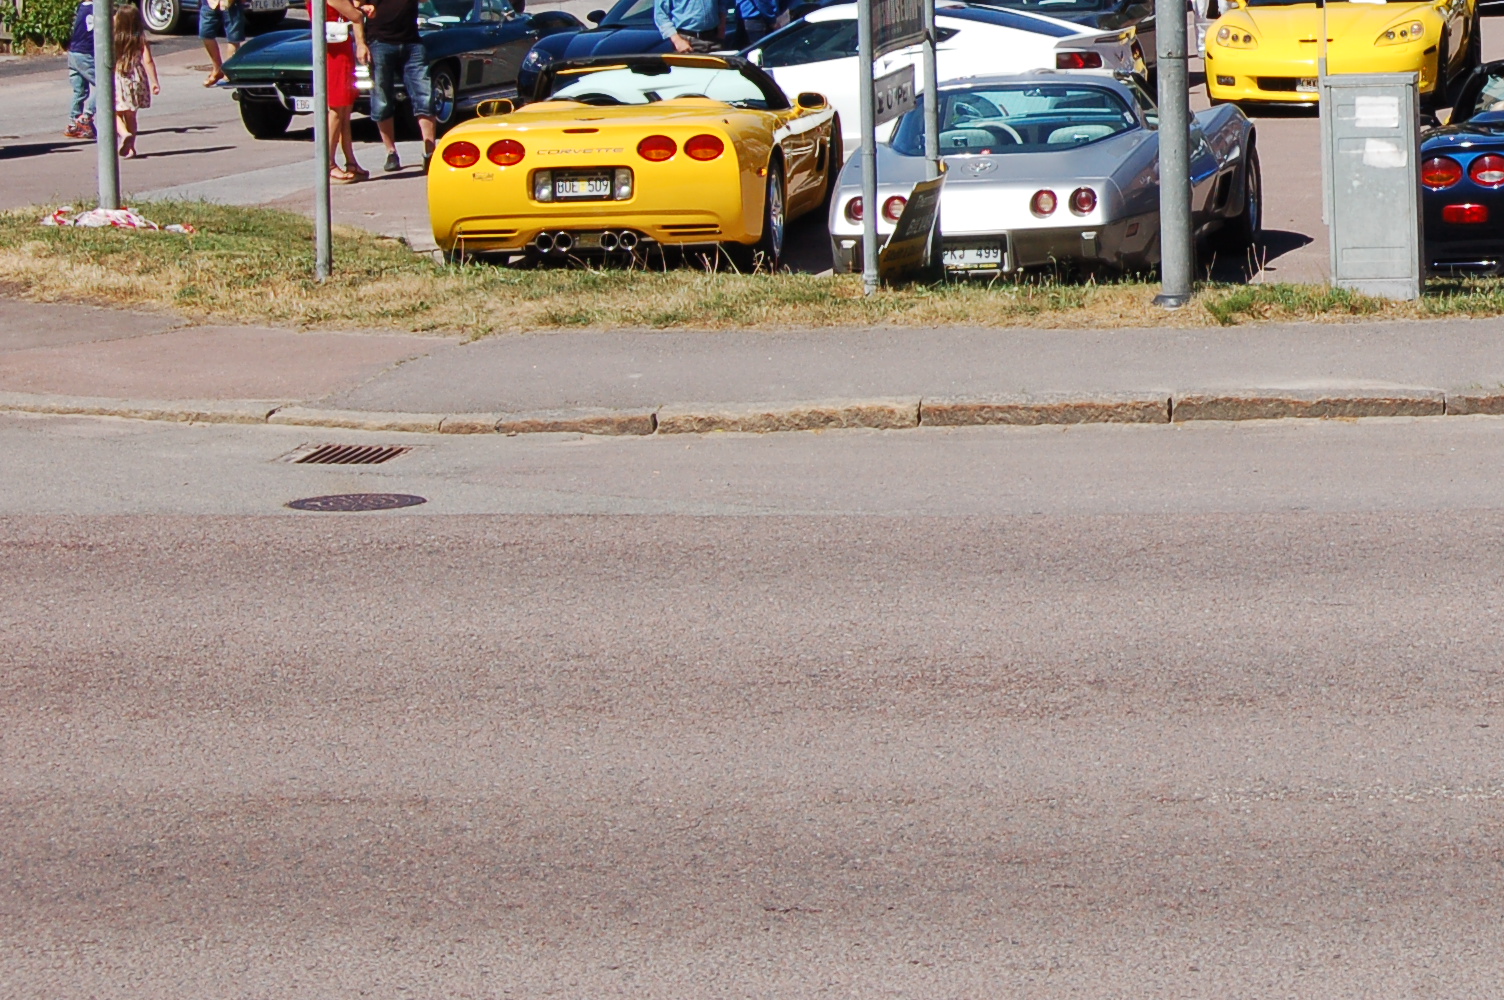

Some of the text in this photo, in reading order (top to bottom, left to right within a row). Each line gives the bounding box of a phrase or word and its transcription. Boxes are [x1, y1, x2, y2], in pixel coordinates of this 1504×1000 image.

[537, 147, 625, 156] CORVETTE
[587, 177, 609, 193] 509
[975, 245, 999, 259] 499
